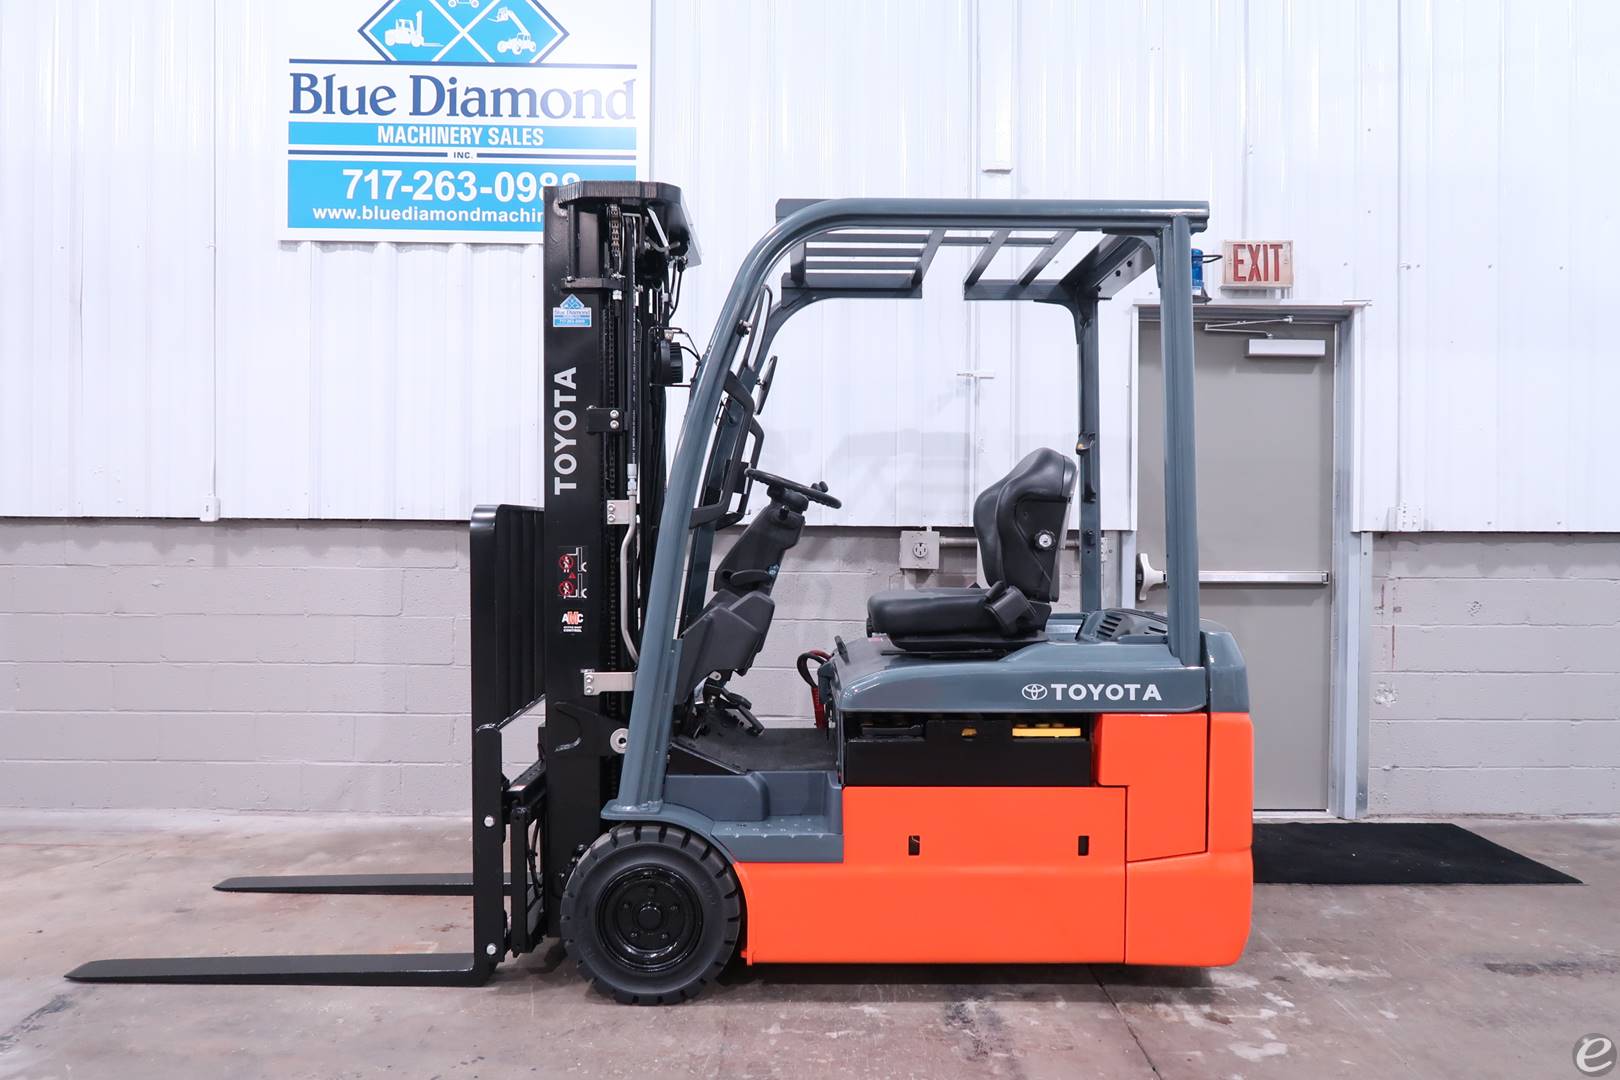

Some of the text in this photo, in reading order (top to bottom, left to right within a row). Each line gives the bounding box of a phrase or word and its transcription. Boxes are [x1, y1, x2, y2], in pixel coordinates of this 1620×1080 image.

[289, 72, 636, 120] Blue Diamond
[377, 125, 544, 146] MACHINERY SALES
[453, 151, 474, 159] INC.
[1232, 243, 1284, 282] EXIT
[553, 366, 577, 495] TOYOTA
[1051, 683, 1162, 701] TOYOTA
